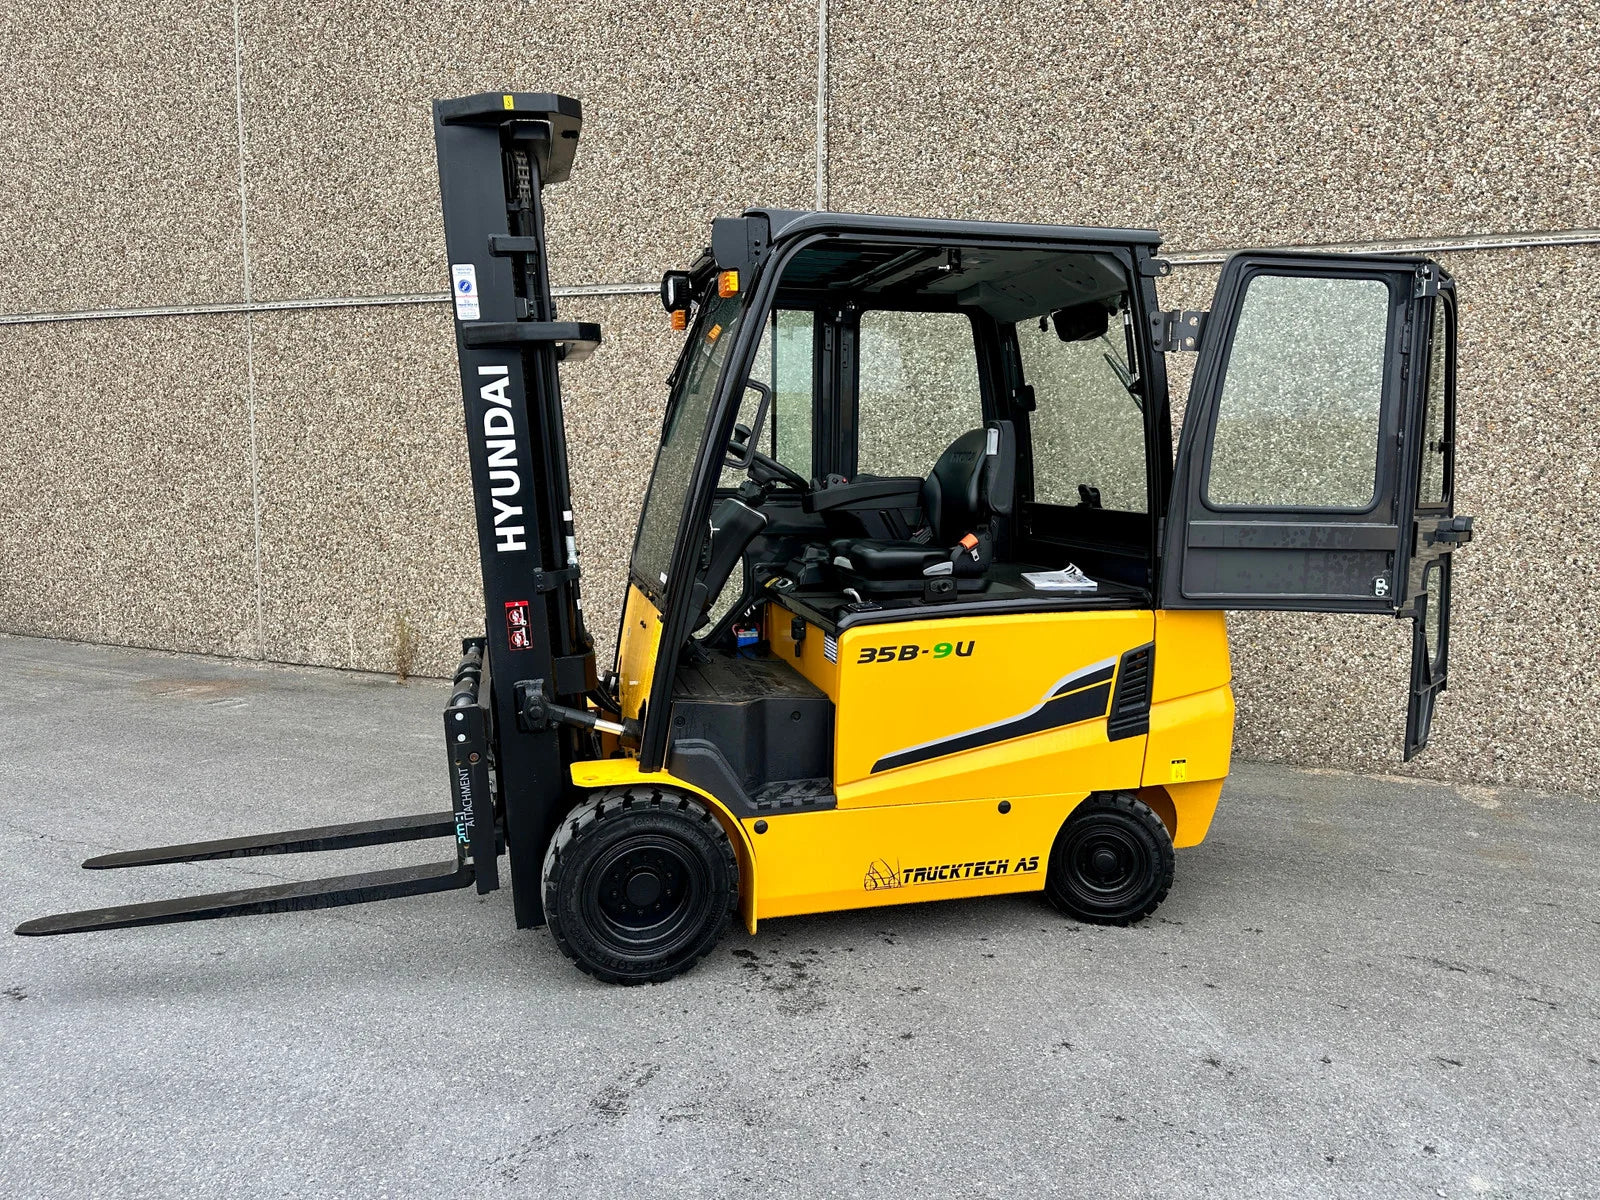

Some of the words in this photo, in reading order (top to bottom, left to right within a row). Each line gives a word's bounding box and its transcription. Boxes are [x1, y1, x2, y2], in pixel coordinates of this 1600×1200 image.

[478, 365, 527, 552] HYUNDAI
[857, 640, 975, 664] 35B-9U
[458, 768, 475, 827] ATTACHMENT
[902, 859, 1010, 884] TRUCKTECH
[1013, 856, 1040, 872] AS
